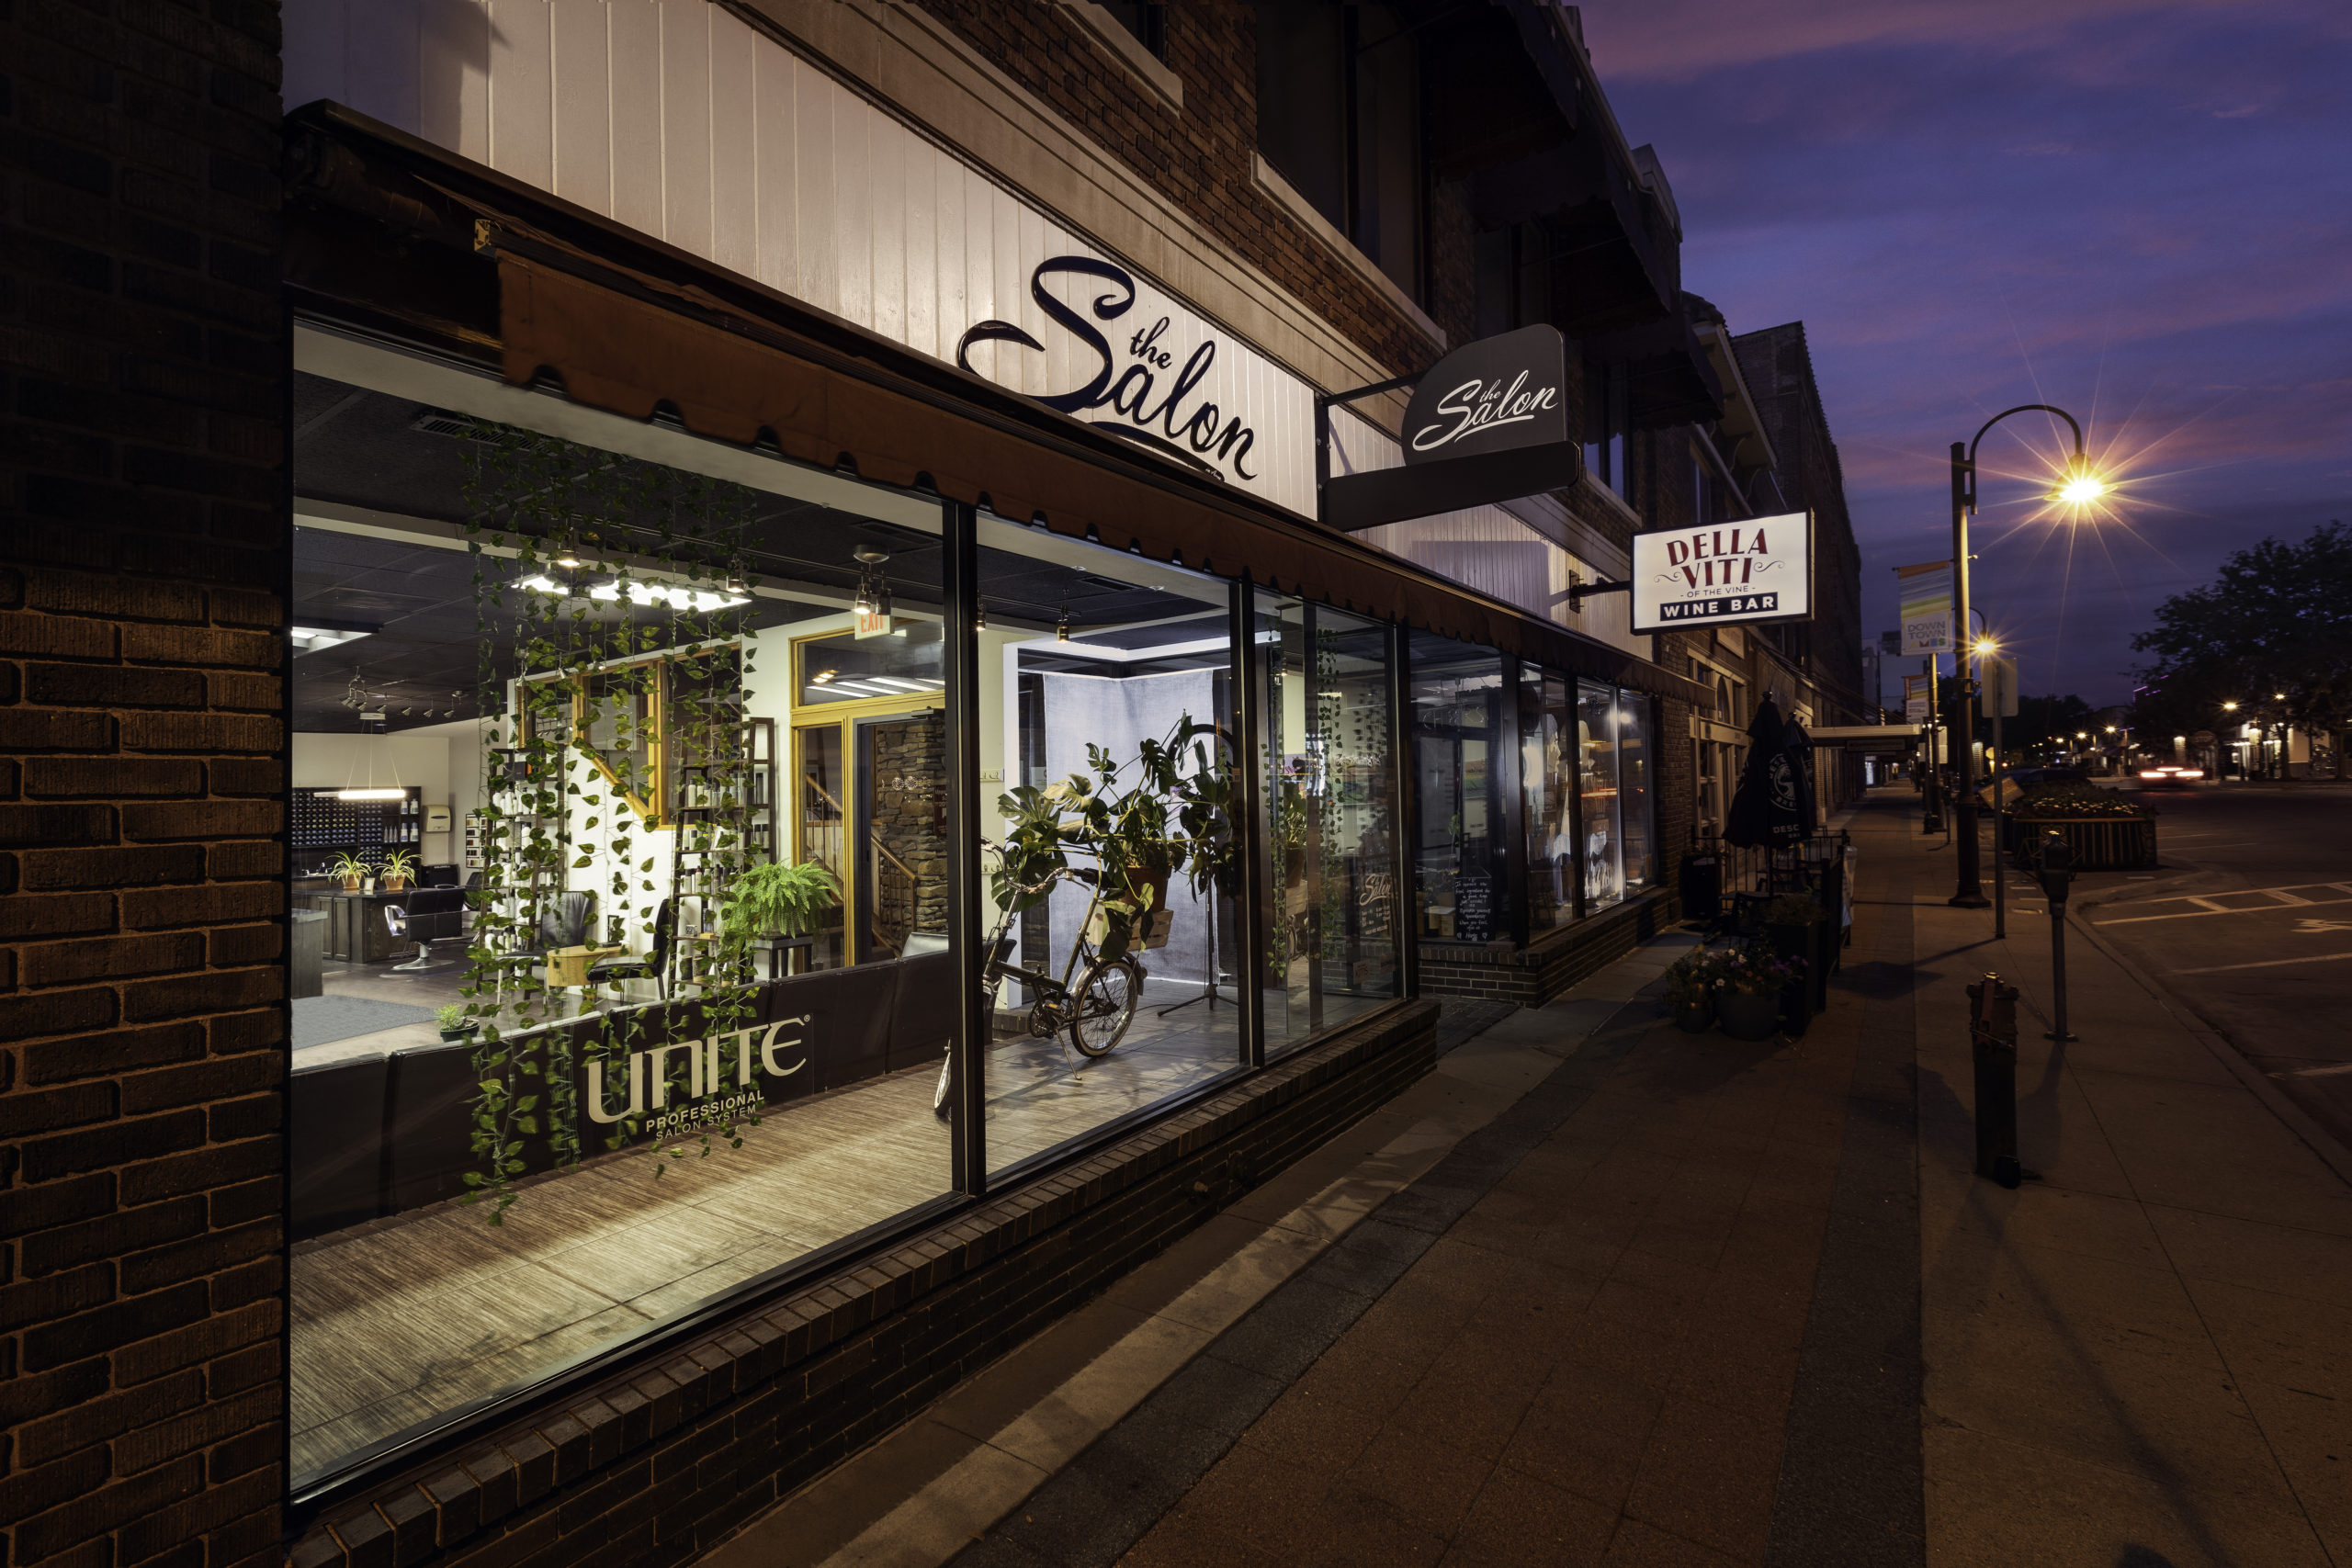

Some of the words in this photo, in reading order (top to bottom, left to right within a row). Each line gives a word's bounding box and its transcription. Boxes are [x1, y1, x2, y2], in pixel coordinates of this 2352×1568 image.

[1130, 316, 1172, 370] the
[957, 255, 1258, 480] Salon
[1480, 378, 1501, 402] the
[1412, 369, 1558, 451] Salon
[1667, 528, 1769, 567] DELLA
[1681, 558, 1753, 589] VITI
[1664, 602, 1718, 617] WINE
[1731, 596, 1774, 612] BAR
[1687, 590, 1700, 598] OF
[1703, 588, 1722, 596] THE
[1726, 585, 1748, 594] VINE
[1908, 621, 1946, 633] DOWN
[1908, 629, 1946, 639] TOWN
[1360, 874, 1392, 907] Salon
[646, 1090, 764, 1133] PROFESSIONAL
[655, 1120, 701, 1141] SALON
[707, 1104, 756, 1126] SYSTEM
